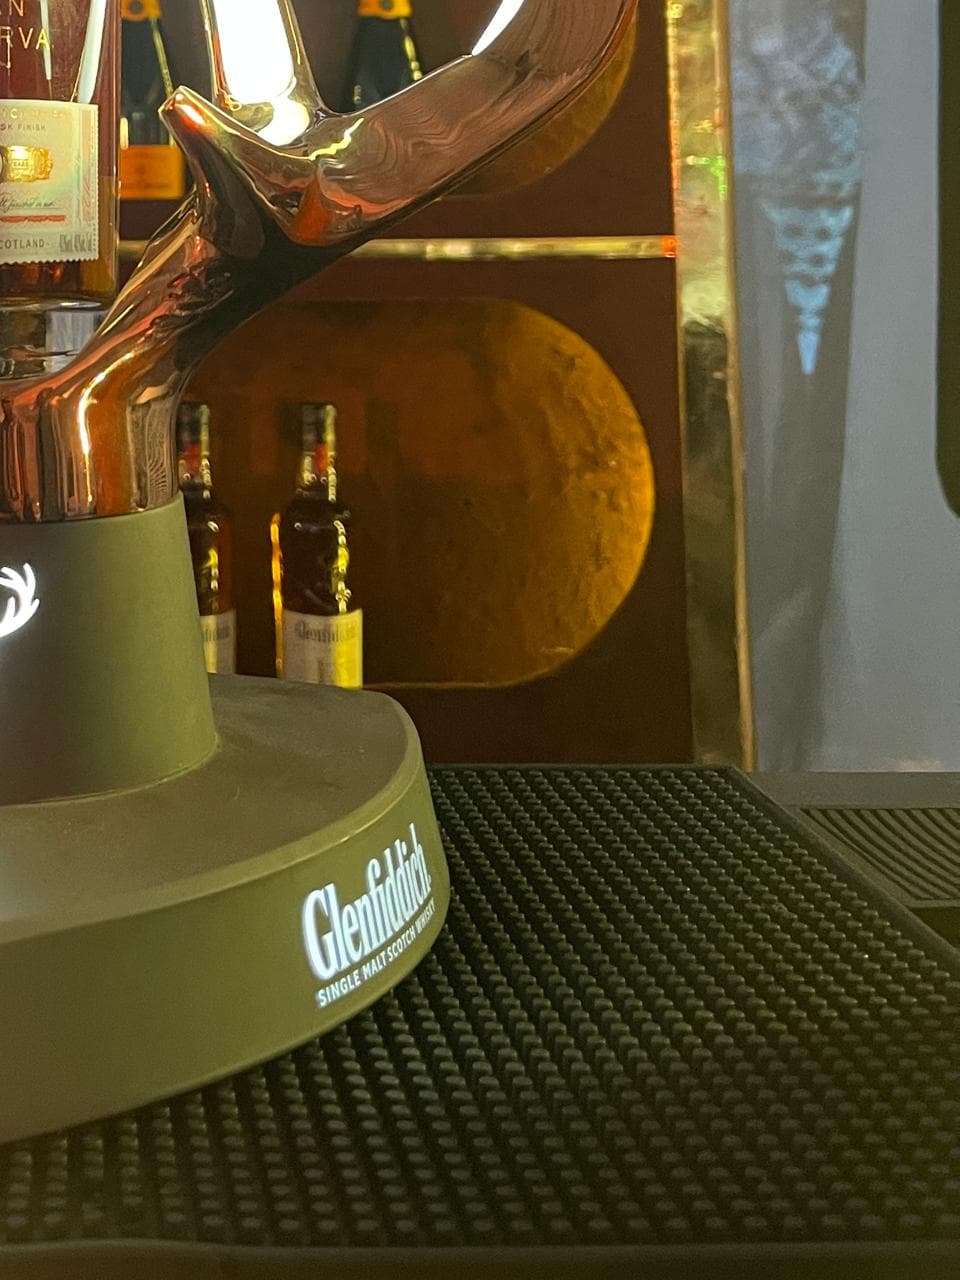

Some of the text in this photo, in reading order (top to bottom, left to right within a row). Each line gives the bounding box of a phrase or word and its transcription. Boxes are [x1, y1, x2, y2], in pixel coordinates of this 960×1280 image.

[302, 822, 432, 981] Glenfiddich
[316, 969, 362, 1008] SINGLE
[361, 952, 388, 981] MALT
[387, 925, 416, 962] SCOTCH
